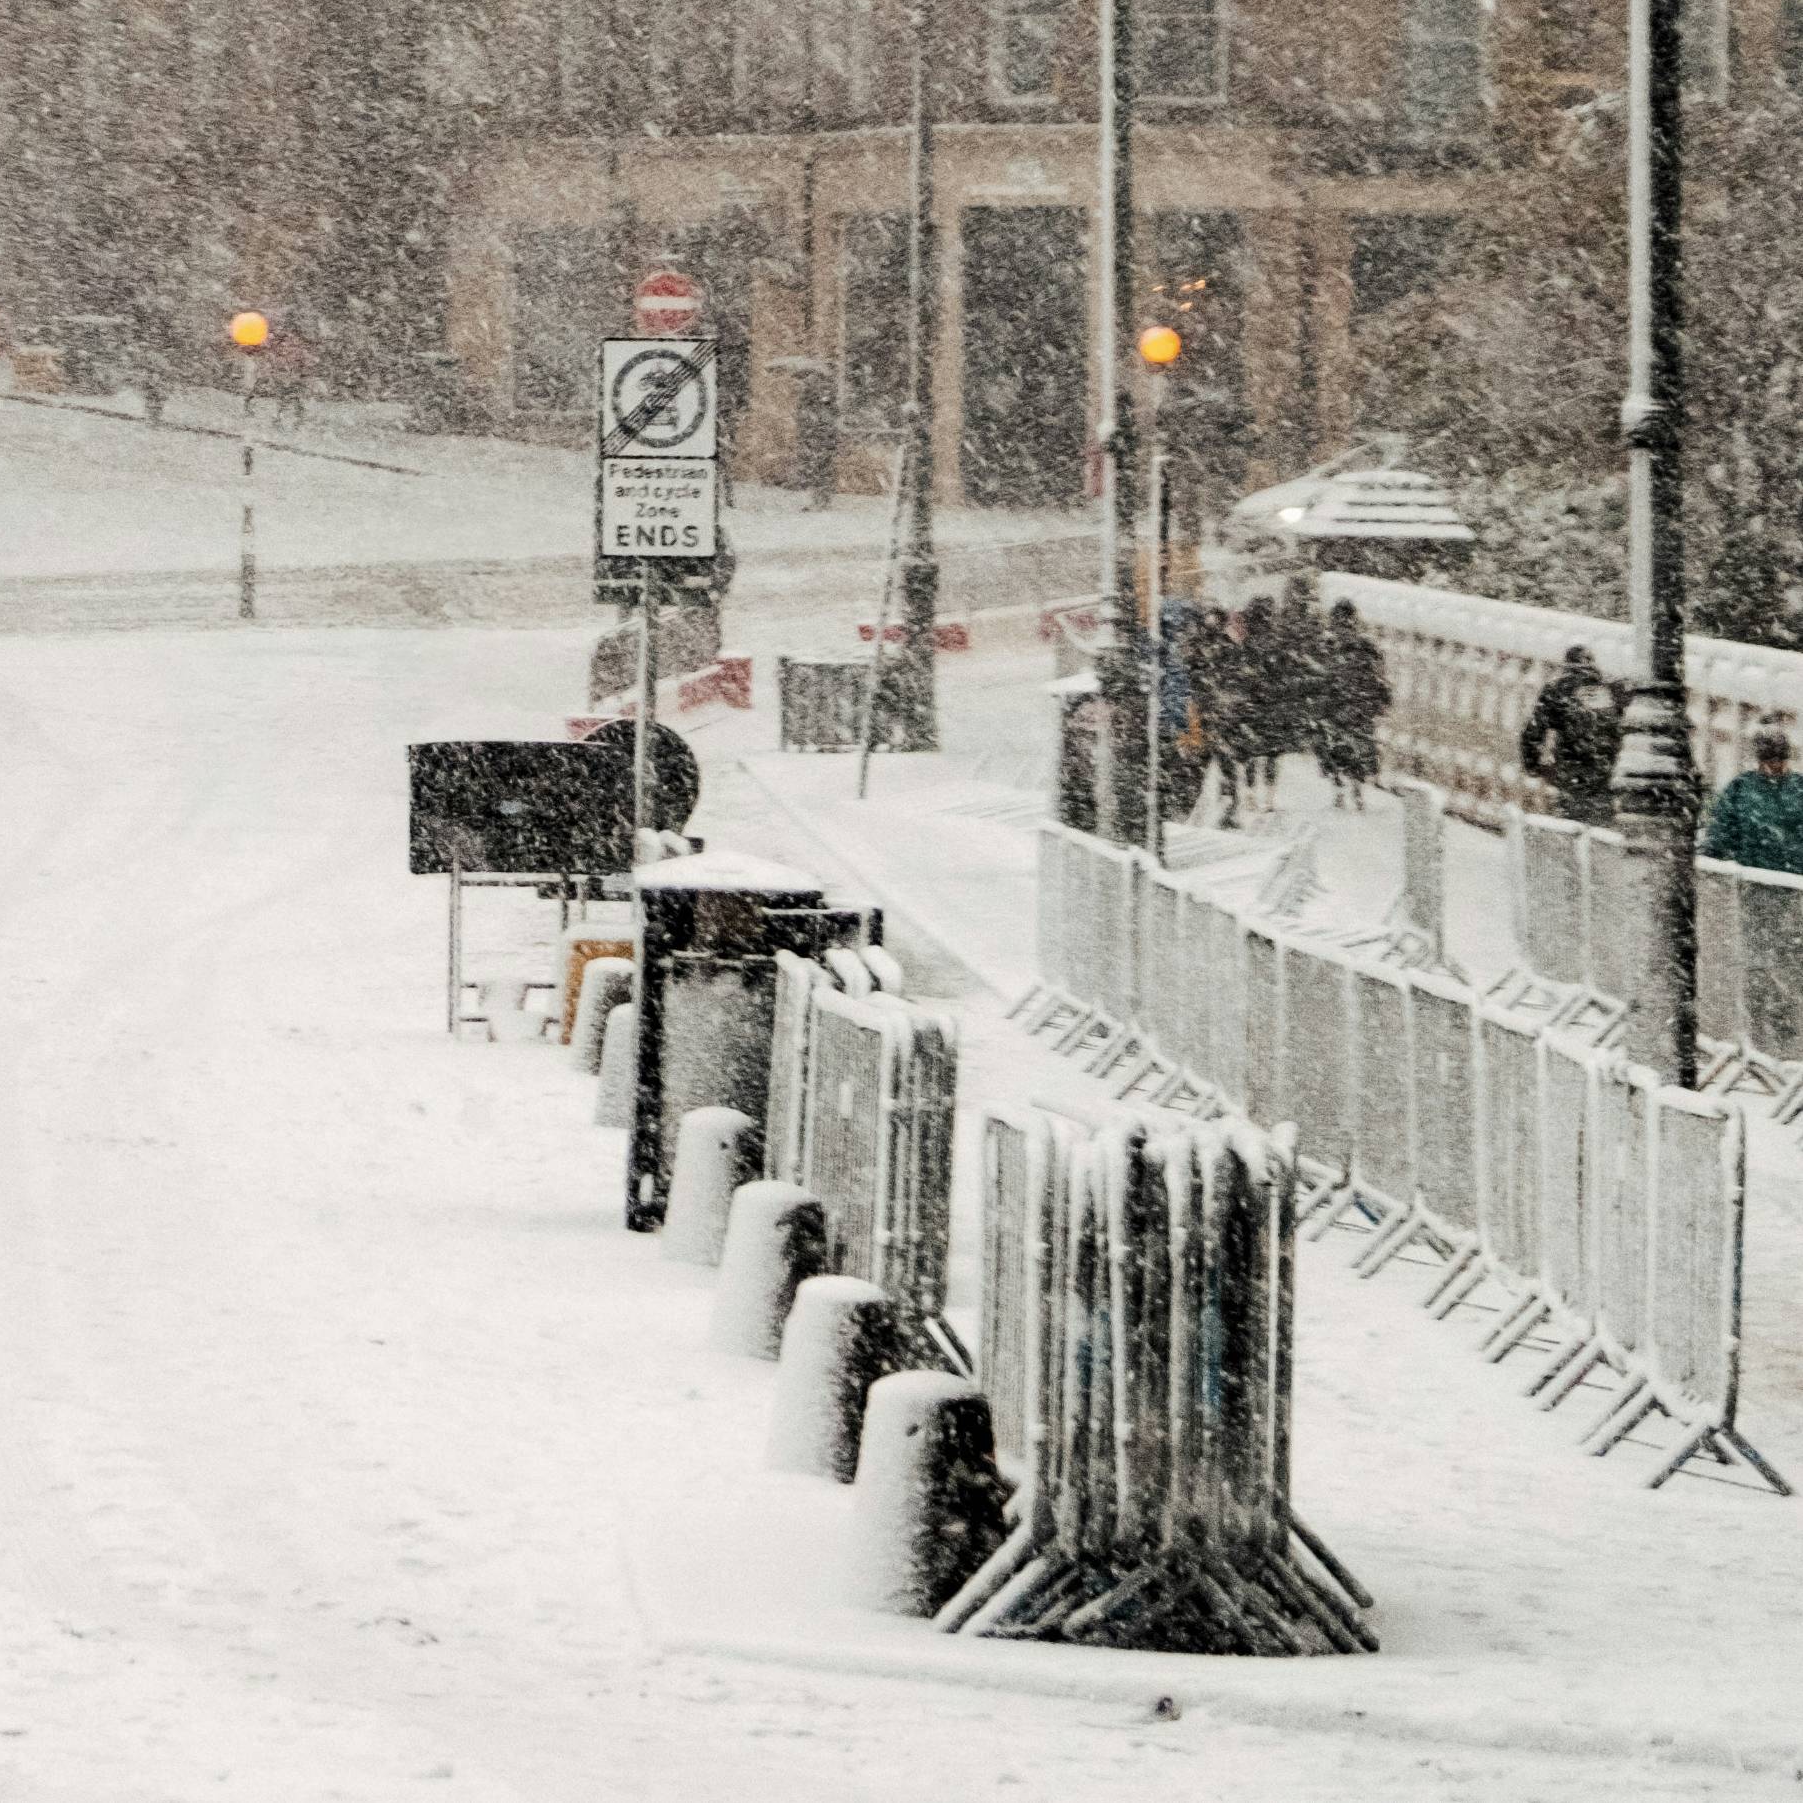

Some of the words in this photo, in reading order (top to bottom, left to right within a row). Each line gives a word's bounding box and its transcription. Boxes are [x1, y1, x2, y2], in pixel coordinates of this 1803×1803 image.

[609, 463, 707, 479] Pedestrian
[615, 485, 649, 497] and
[653, 483, 701, 500] cycle
[636, 502, 679, 518] Zone
[617, 525, 699, 547] ENDS
